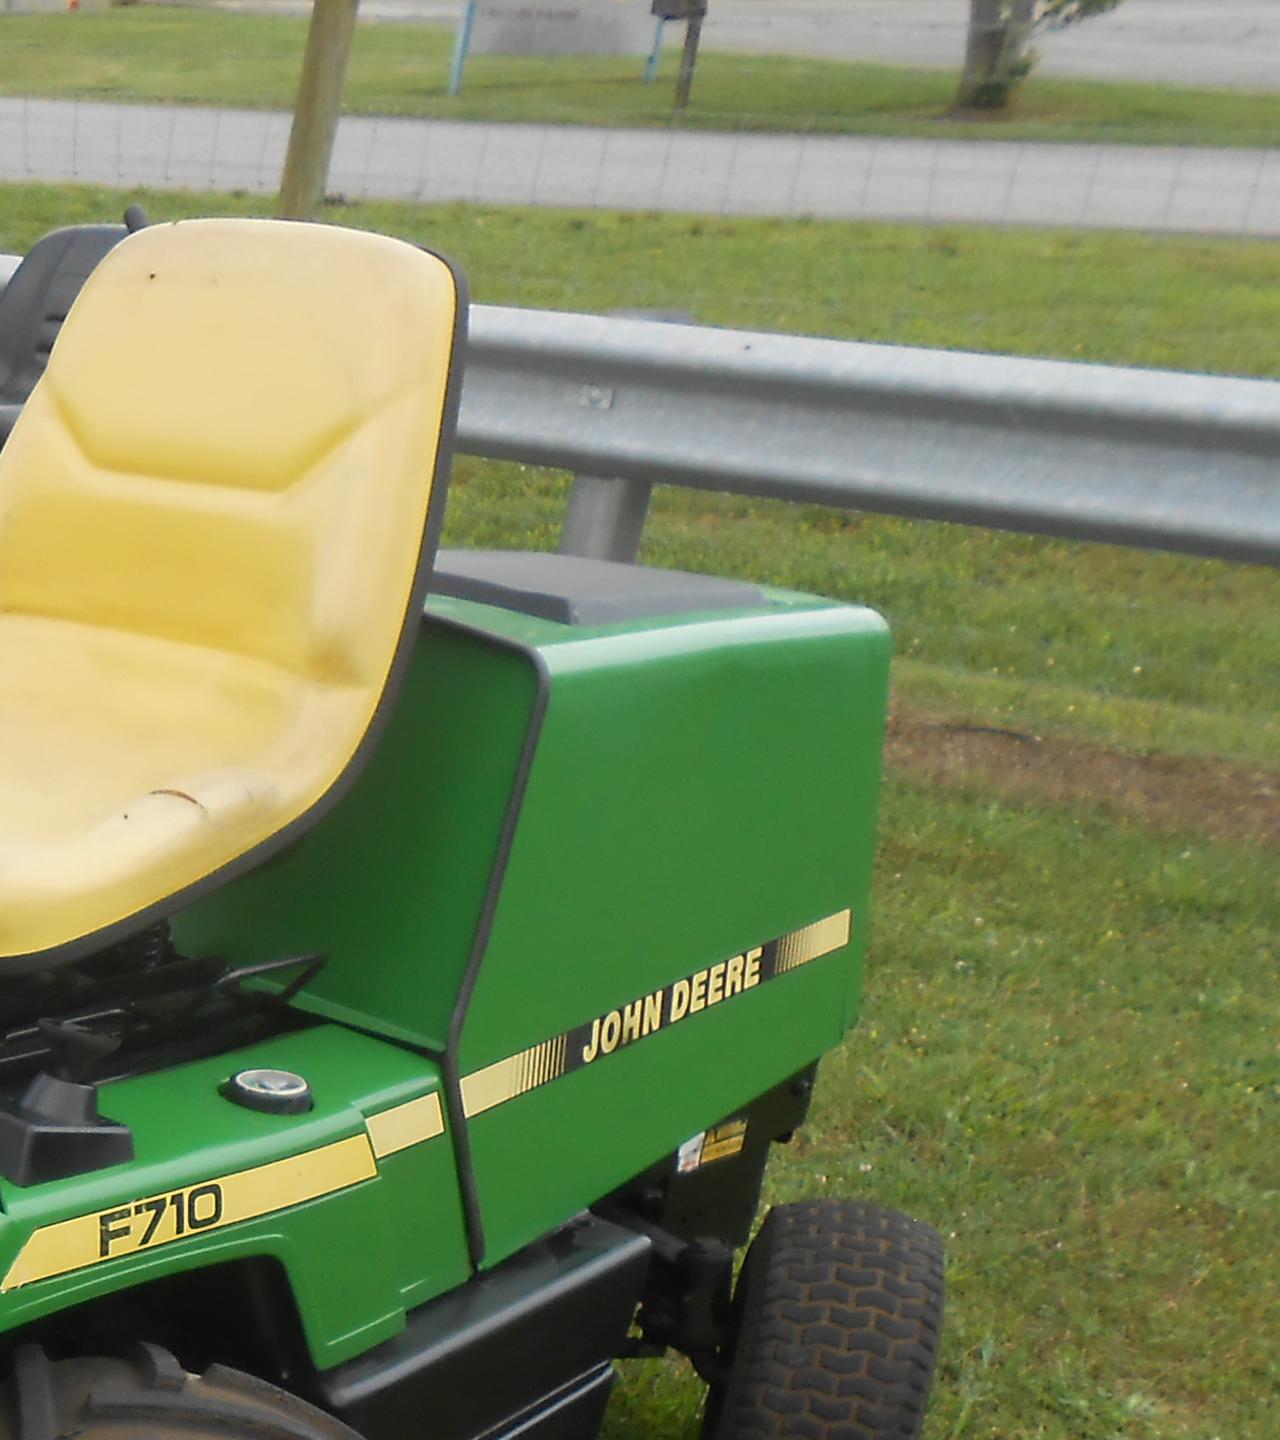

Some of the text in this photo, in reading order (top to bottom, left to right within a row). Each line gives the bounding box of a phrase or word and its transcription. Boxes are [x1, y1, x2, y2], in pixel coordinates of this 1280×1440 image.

[582, 946, 764, 1063] JOHN DEERE
[100, 1183, 223, 1258] F710
